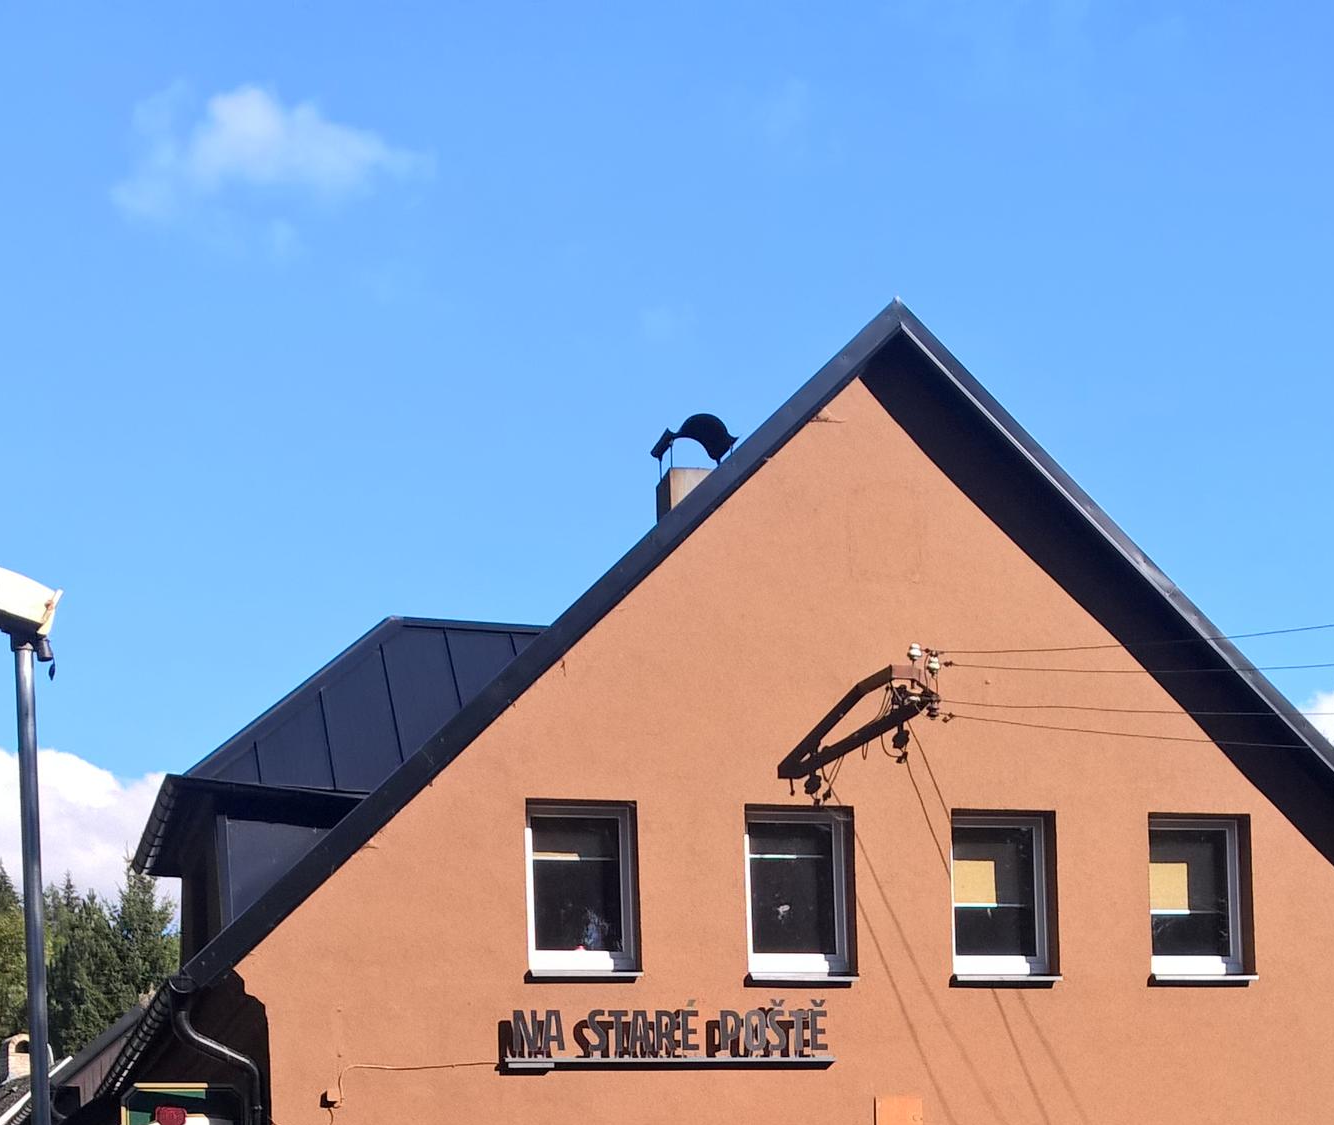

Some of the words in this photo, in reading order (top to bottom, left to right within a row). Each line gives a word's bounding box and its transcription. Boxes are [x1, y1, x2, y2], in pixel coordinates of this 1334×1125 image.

[511, 1009, 566, 1051] NA
[587, 999, 700, 1051] STARÉ
[719, 999, 829, 1051] POŠTĚ
